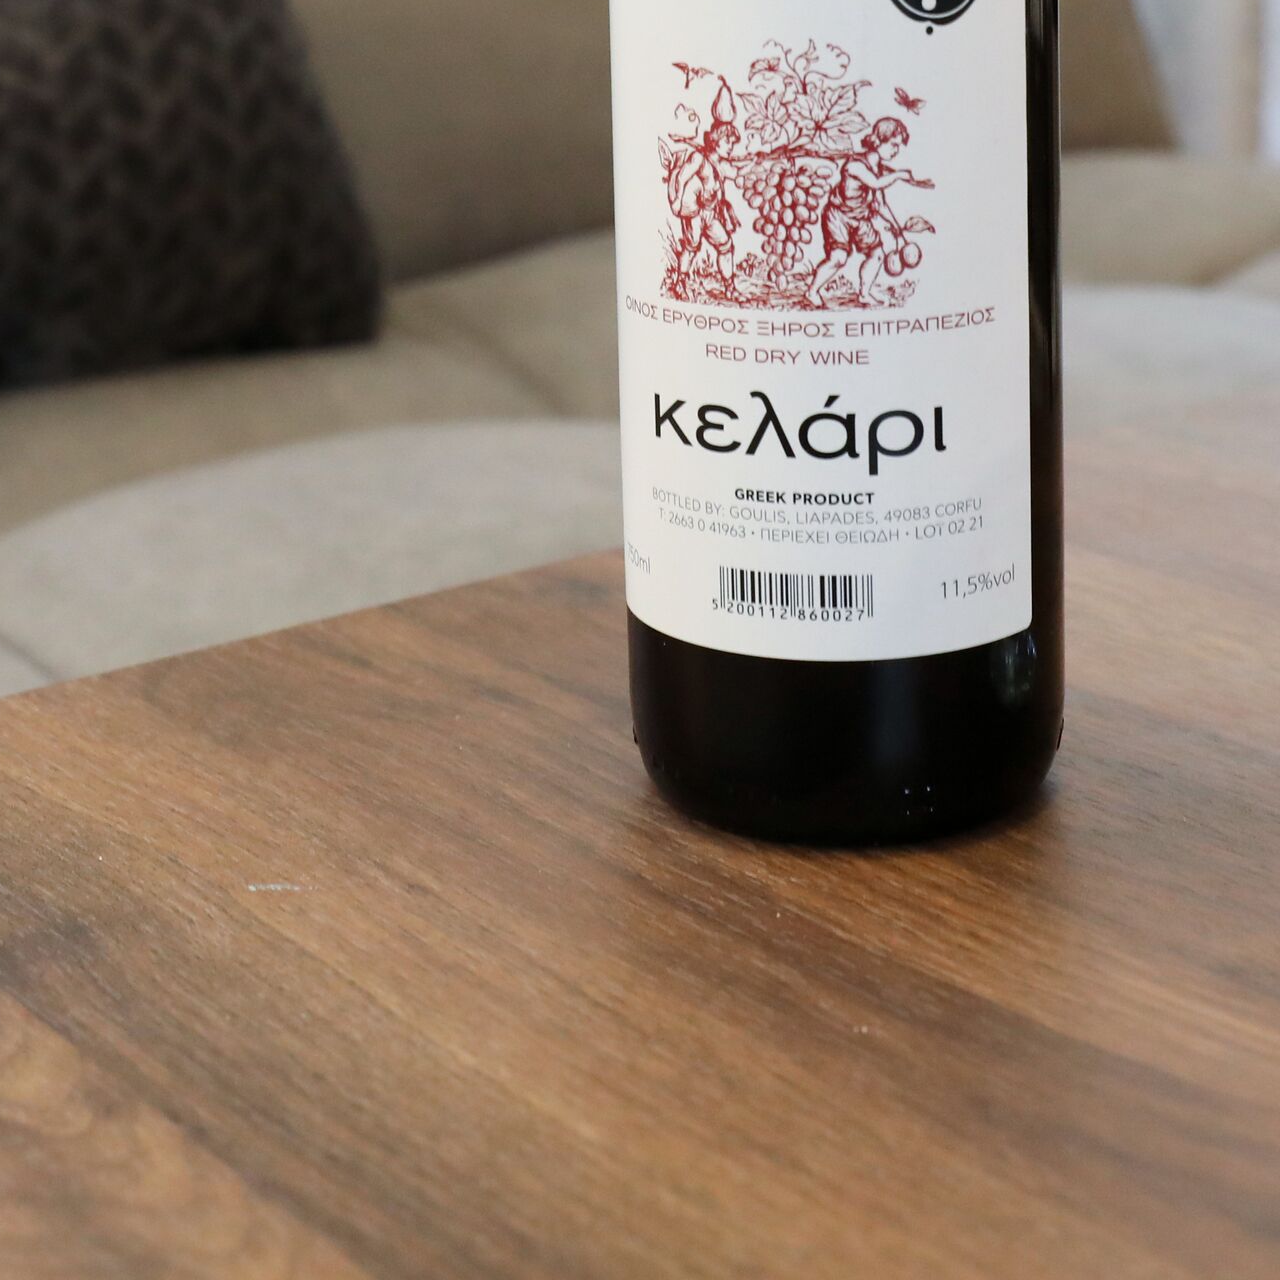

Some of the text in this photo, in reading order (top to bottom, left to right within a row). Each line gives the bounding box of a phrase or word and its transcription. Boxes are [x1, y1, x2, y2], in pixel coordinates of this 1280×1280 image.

[625, 295, 996, 338] ΟΙΝΟΣ ΕΡΥΘΡΟΣ ΞΗΡΟΣ ΕΠΙΤΡΑΠΕΖΙΟΣ
[705, 343, 870, 365] RED DRY WINE
[654, 391, 947, 476] κελάρι
[652, 486, 982, 525] BOTTLED BY: GOULIS, LIAPADES, 49083 CORFU
[734, 488, 875, 505] GREEK PRODUCT
[669, 511, 694, 529] 2663
[709, 521, 746, 539] 41963
[761, 527, 829, 544] ΠΕΡΙΕΧΕΙ
[835, 528, 899, 544] ΘΕΙΩΔΗ
[915, 524, 943, 540] LOT
[948, 519, 965, 535] 02
[969, 515, 983, 531] 21
[941, 563, 1015, 599] 11,5%vol
